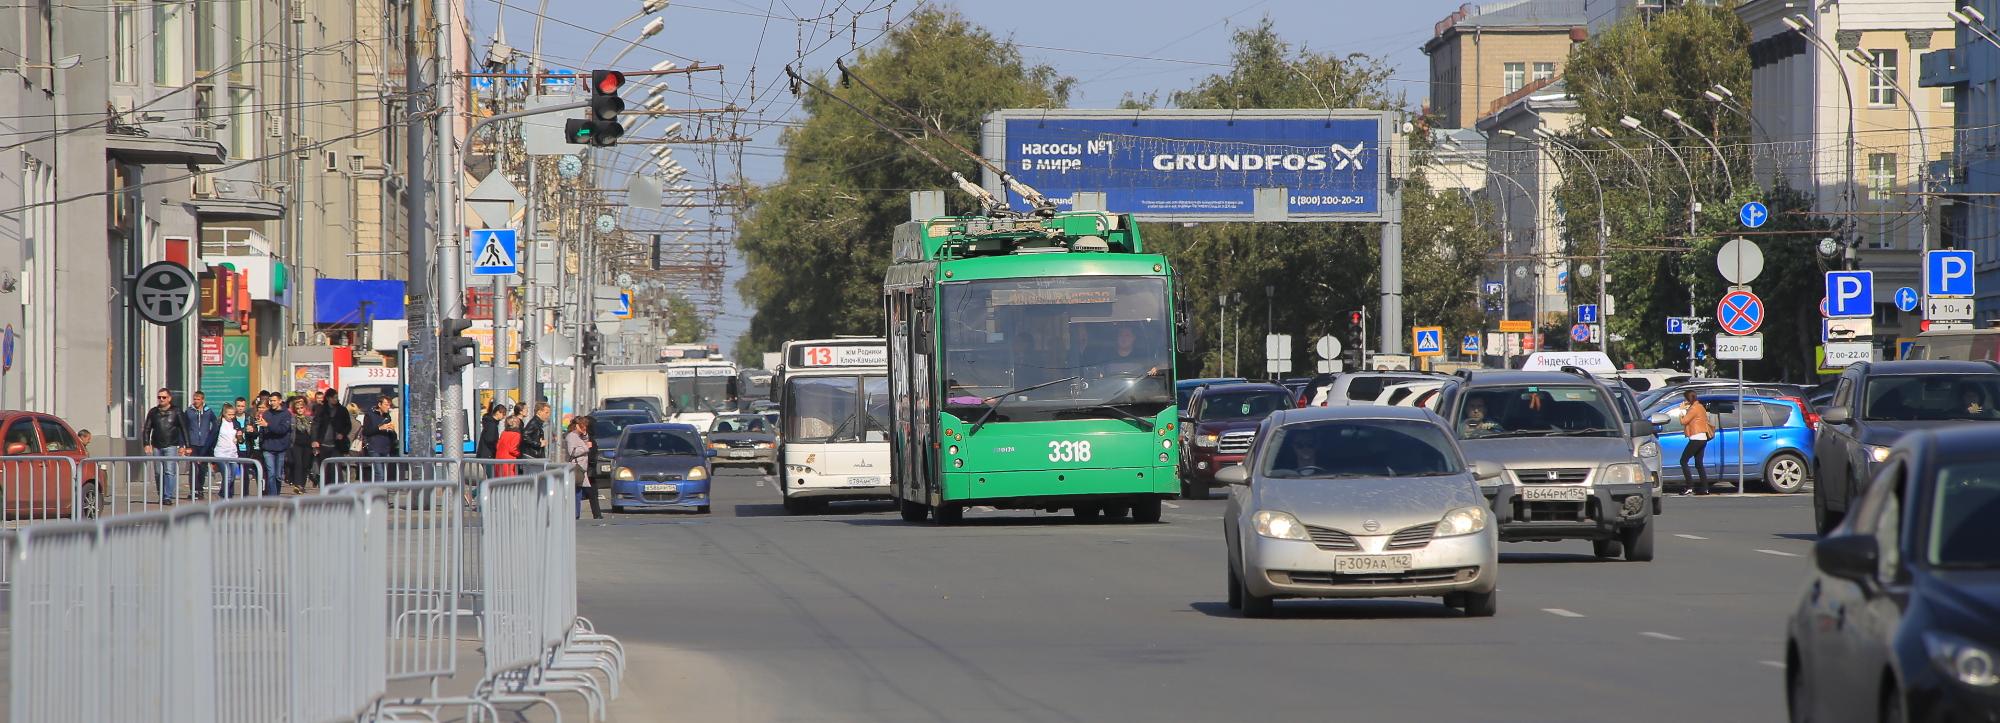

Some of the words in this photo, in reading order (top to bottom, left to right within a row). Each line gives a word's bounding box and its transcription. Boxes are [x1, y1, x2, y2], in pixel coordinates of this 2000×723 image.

[1022, 144, 1081, 155] насосы
[1087, 140, 1112, 155] №1
[1022, 159, 1032, 170] в
[1036, 159, 1082, 174] мире
[1153, 154, 1327, 171] GRUNDFOS
[1290, 196, 1296, 204] 8
[1297, 195, 1320, 206] (800)
[1322, 196, 1364, 204] 200-20-21
[1941, 256, 1967, 292] P
[1837, 276, 1862, 312] P
[807, 348, 832, 365] 13
[1537, 356, 1571, 366] Яндекс
[1572, 355, 1601, 366] Такси
[1829, 351, 1869, 359] 7.00-22.00
[368, 368, 383, 377] 333
[1048, 440, 1091, 462] 3318
